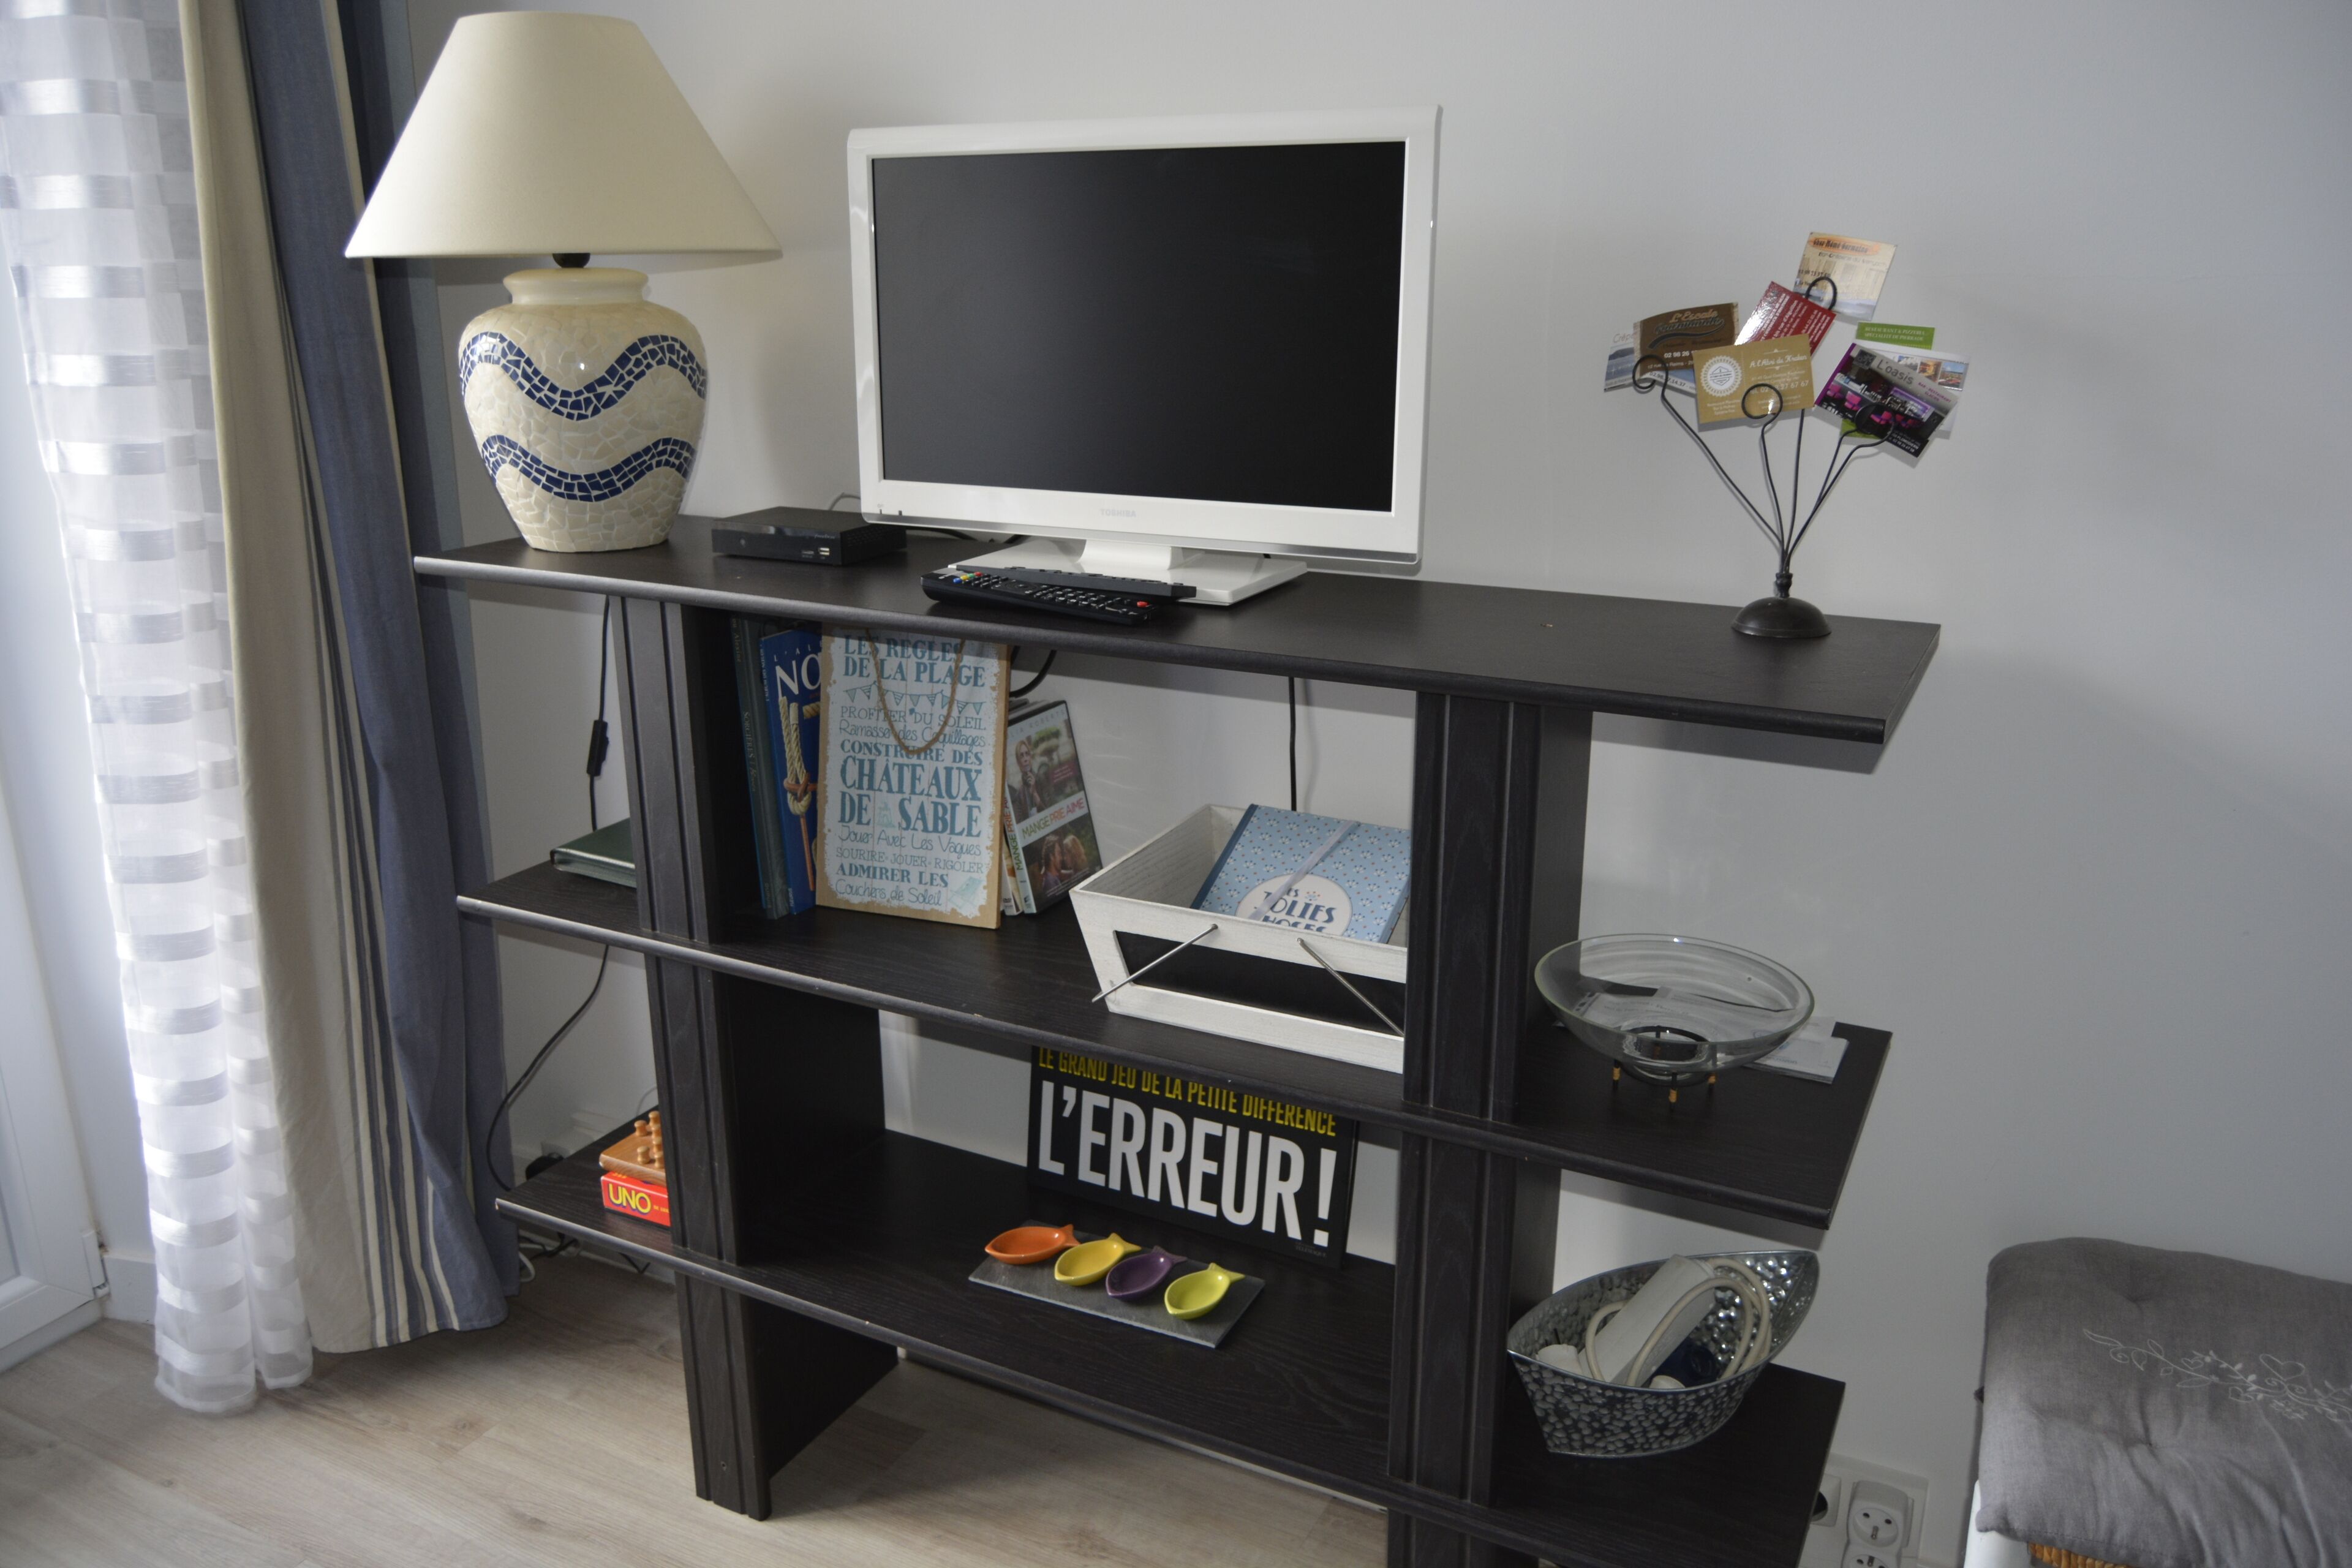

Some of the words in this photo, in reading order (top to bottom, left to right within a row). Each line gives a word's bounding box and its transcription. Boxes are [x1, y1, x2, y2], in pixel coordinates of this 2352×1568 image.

[1876, 359, 1913, 385] L'oasis
[1101, 508, 1137, 518] TOSHIBA
[843, 635, 879, 655] LES
[843, 656, 870, 678] DE
[880, 659, 907, 681] LA
[914, 662, 985, 687] PLAGE
[840, 706, 907, 723] PROFITER
[913, 712, 933, 726] DU
[938, 714, 987, 731] SOLEIL
[899, 725, 918, 741] des
[840, 739, 944, 762] CONSTRUIRE
[952, 749, 983, 766] DES
[840, 755, 982, 801] CHÂTEAUX
[838, 791, 871, 826] DE
[899, 796, 981, 837] SABLE
[1004, 813, 1014, 832] PRIE
[1022, 815, 1050, 837] MANGE
[1050, 807, 1065, 824] PRIE
[1066, 797, 1085, 816] AIME
[838, 825, 872, 843] Jouer
[877, 830, 907, 848] Avec
[911, 833, 933, 851] Les
[938, 836, 981, 859] Vagues
[1009, 834, 1023, 870] MANGE
[836, 847, 885, 862] SOURIRE
[891, 853, 927, 867] JOUER
[934, 859, 984, 873] RIGOLER
[836, 862, 911, 883] ADMIRER
[919, 871, 949, 888] LES
[835, 878, 886, 900] Couchers
[890, 885, 905, 901] de
[908, 888, 943, 906] Soleil
[1039, 1047, 1055, 1069] LE
[1058, 1052, 1107, 1082] GRAND
[1112, 1064, 1137, 1089] JEU
[1142, 1071, 1160, 1095] DE
[1166, 1076, 1183, 1101] LA
[1188, 1082, 1238, 1114] PETITE
[1039, 1080, 1305, 1241] L'ERREUR
[608, 1183, 651, 1214] UNO
